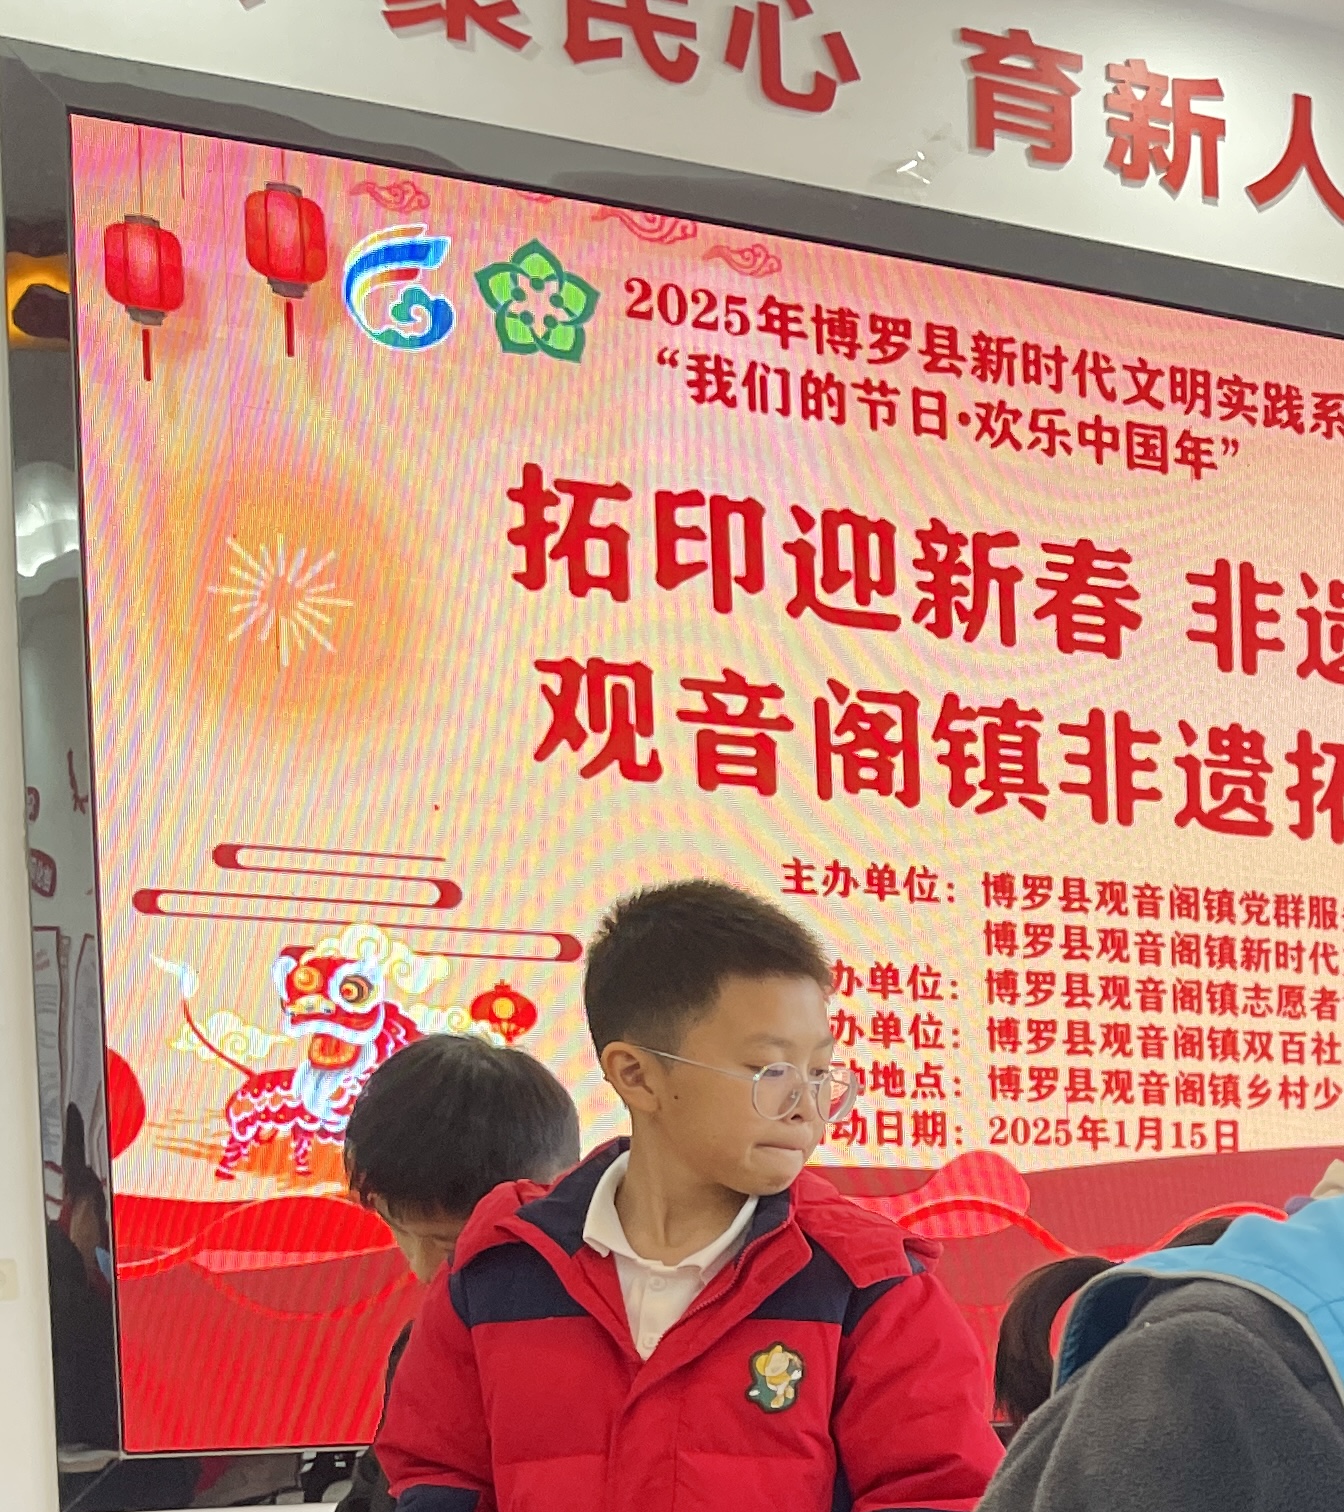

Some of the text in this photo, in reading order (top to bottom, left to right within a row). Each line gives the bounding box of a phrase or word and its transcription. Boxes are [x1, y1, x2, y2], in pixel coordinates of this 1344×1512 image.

[507, 463, 1143, 661] 拓印迎新春
[831, 959, 959, 1001] 办单位：
[830, 1009, 960, 1051] 办单位：
[831, 1059, 961, 1101] 地点：
[820, 1109, 1240, 1154] 动日期： 2025年1月15日
